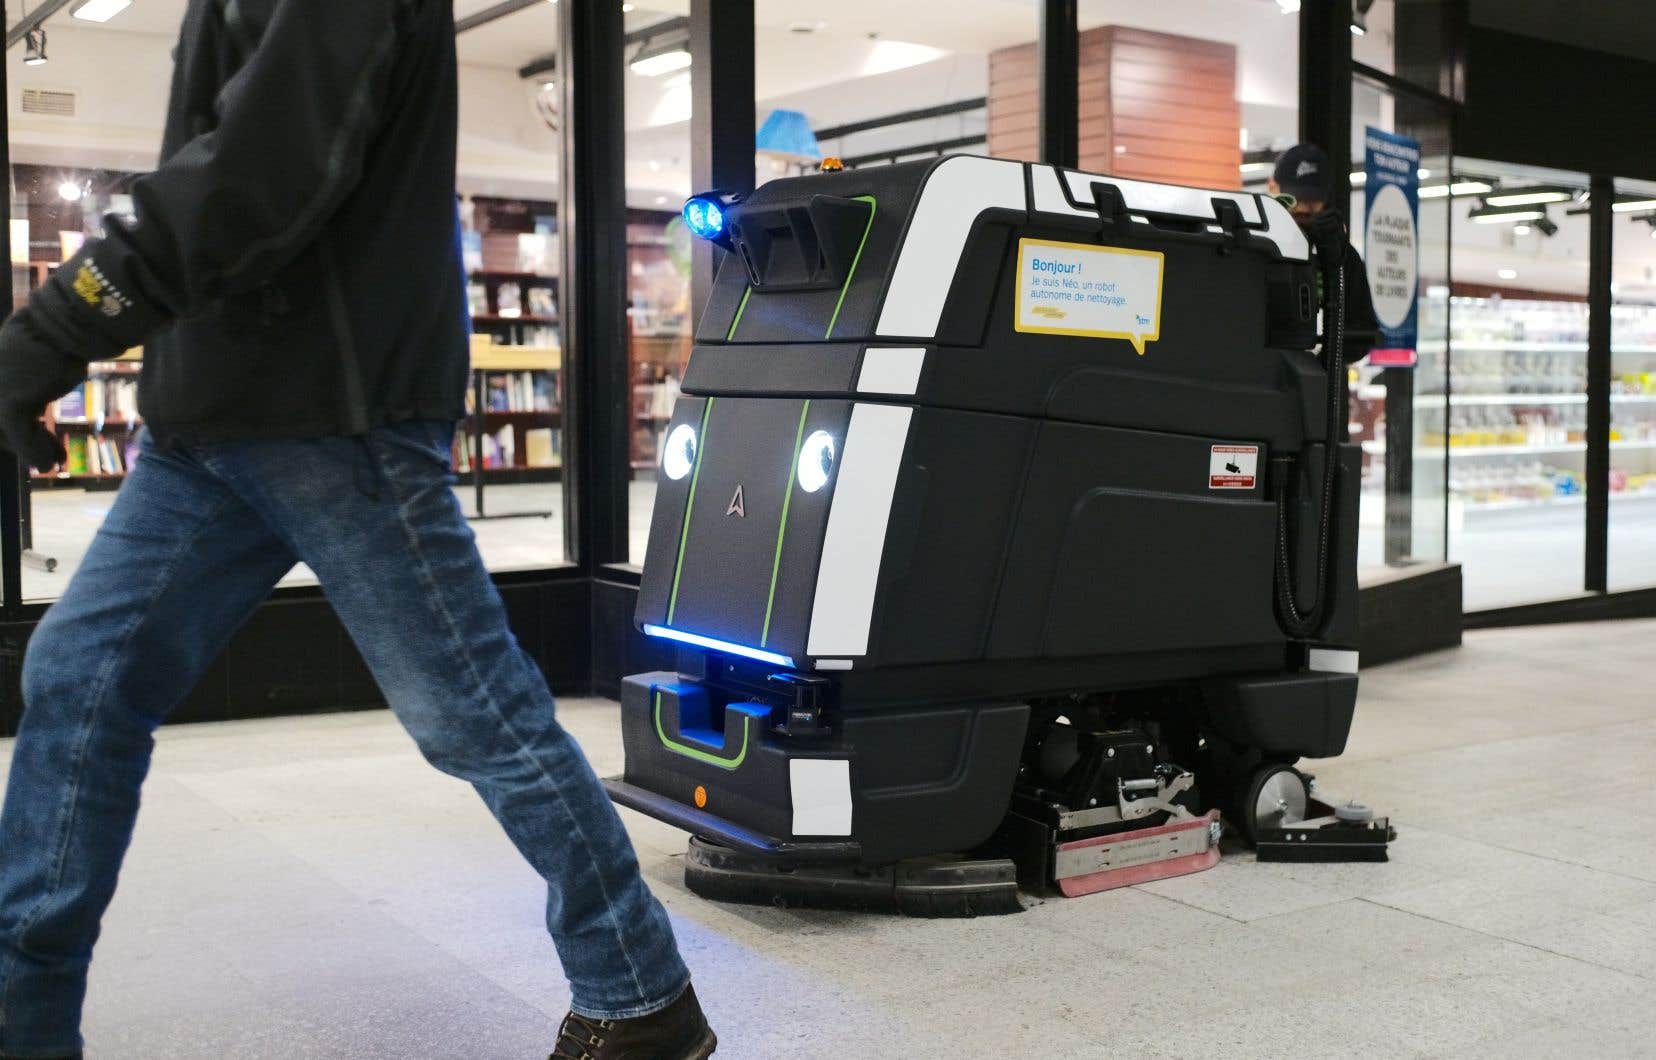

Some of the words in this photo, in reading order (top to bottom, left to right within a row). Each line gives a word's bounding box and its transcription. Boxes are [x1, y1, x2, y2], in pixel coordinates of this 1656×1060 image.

[1032, 258, 1075, 275] Bonjour
[1031, 275, 1041, 286] Je
[1042, 277, 1059, 287] suis
[1082, 282, 1093, 290] un
[1095, 281, 1115, 292] robot
[1030, 290, 1072, 301] autonome
[1074, 291, 1085, 302] de
[1087, 294, 1128, 307] nettoyage.
